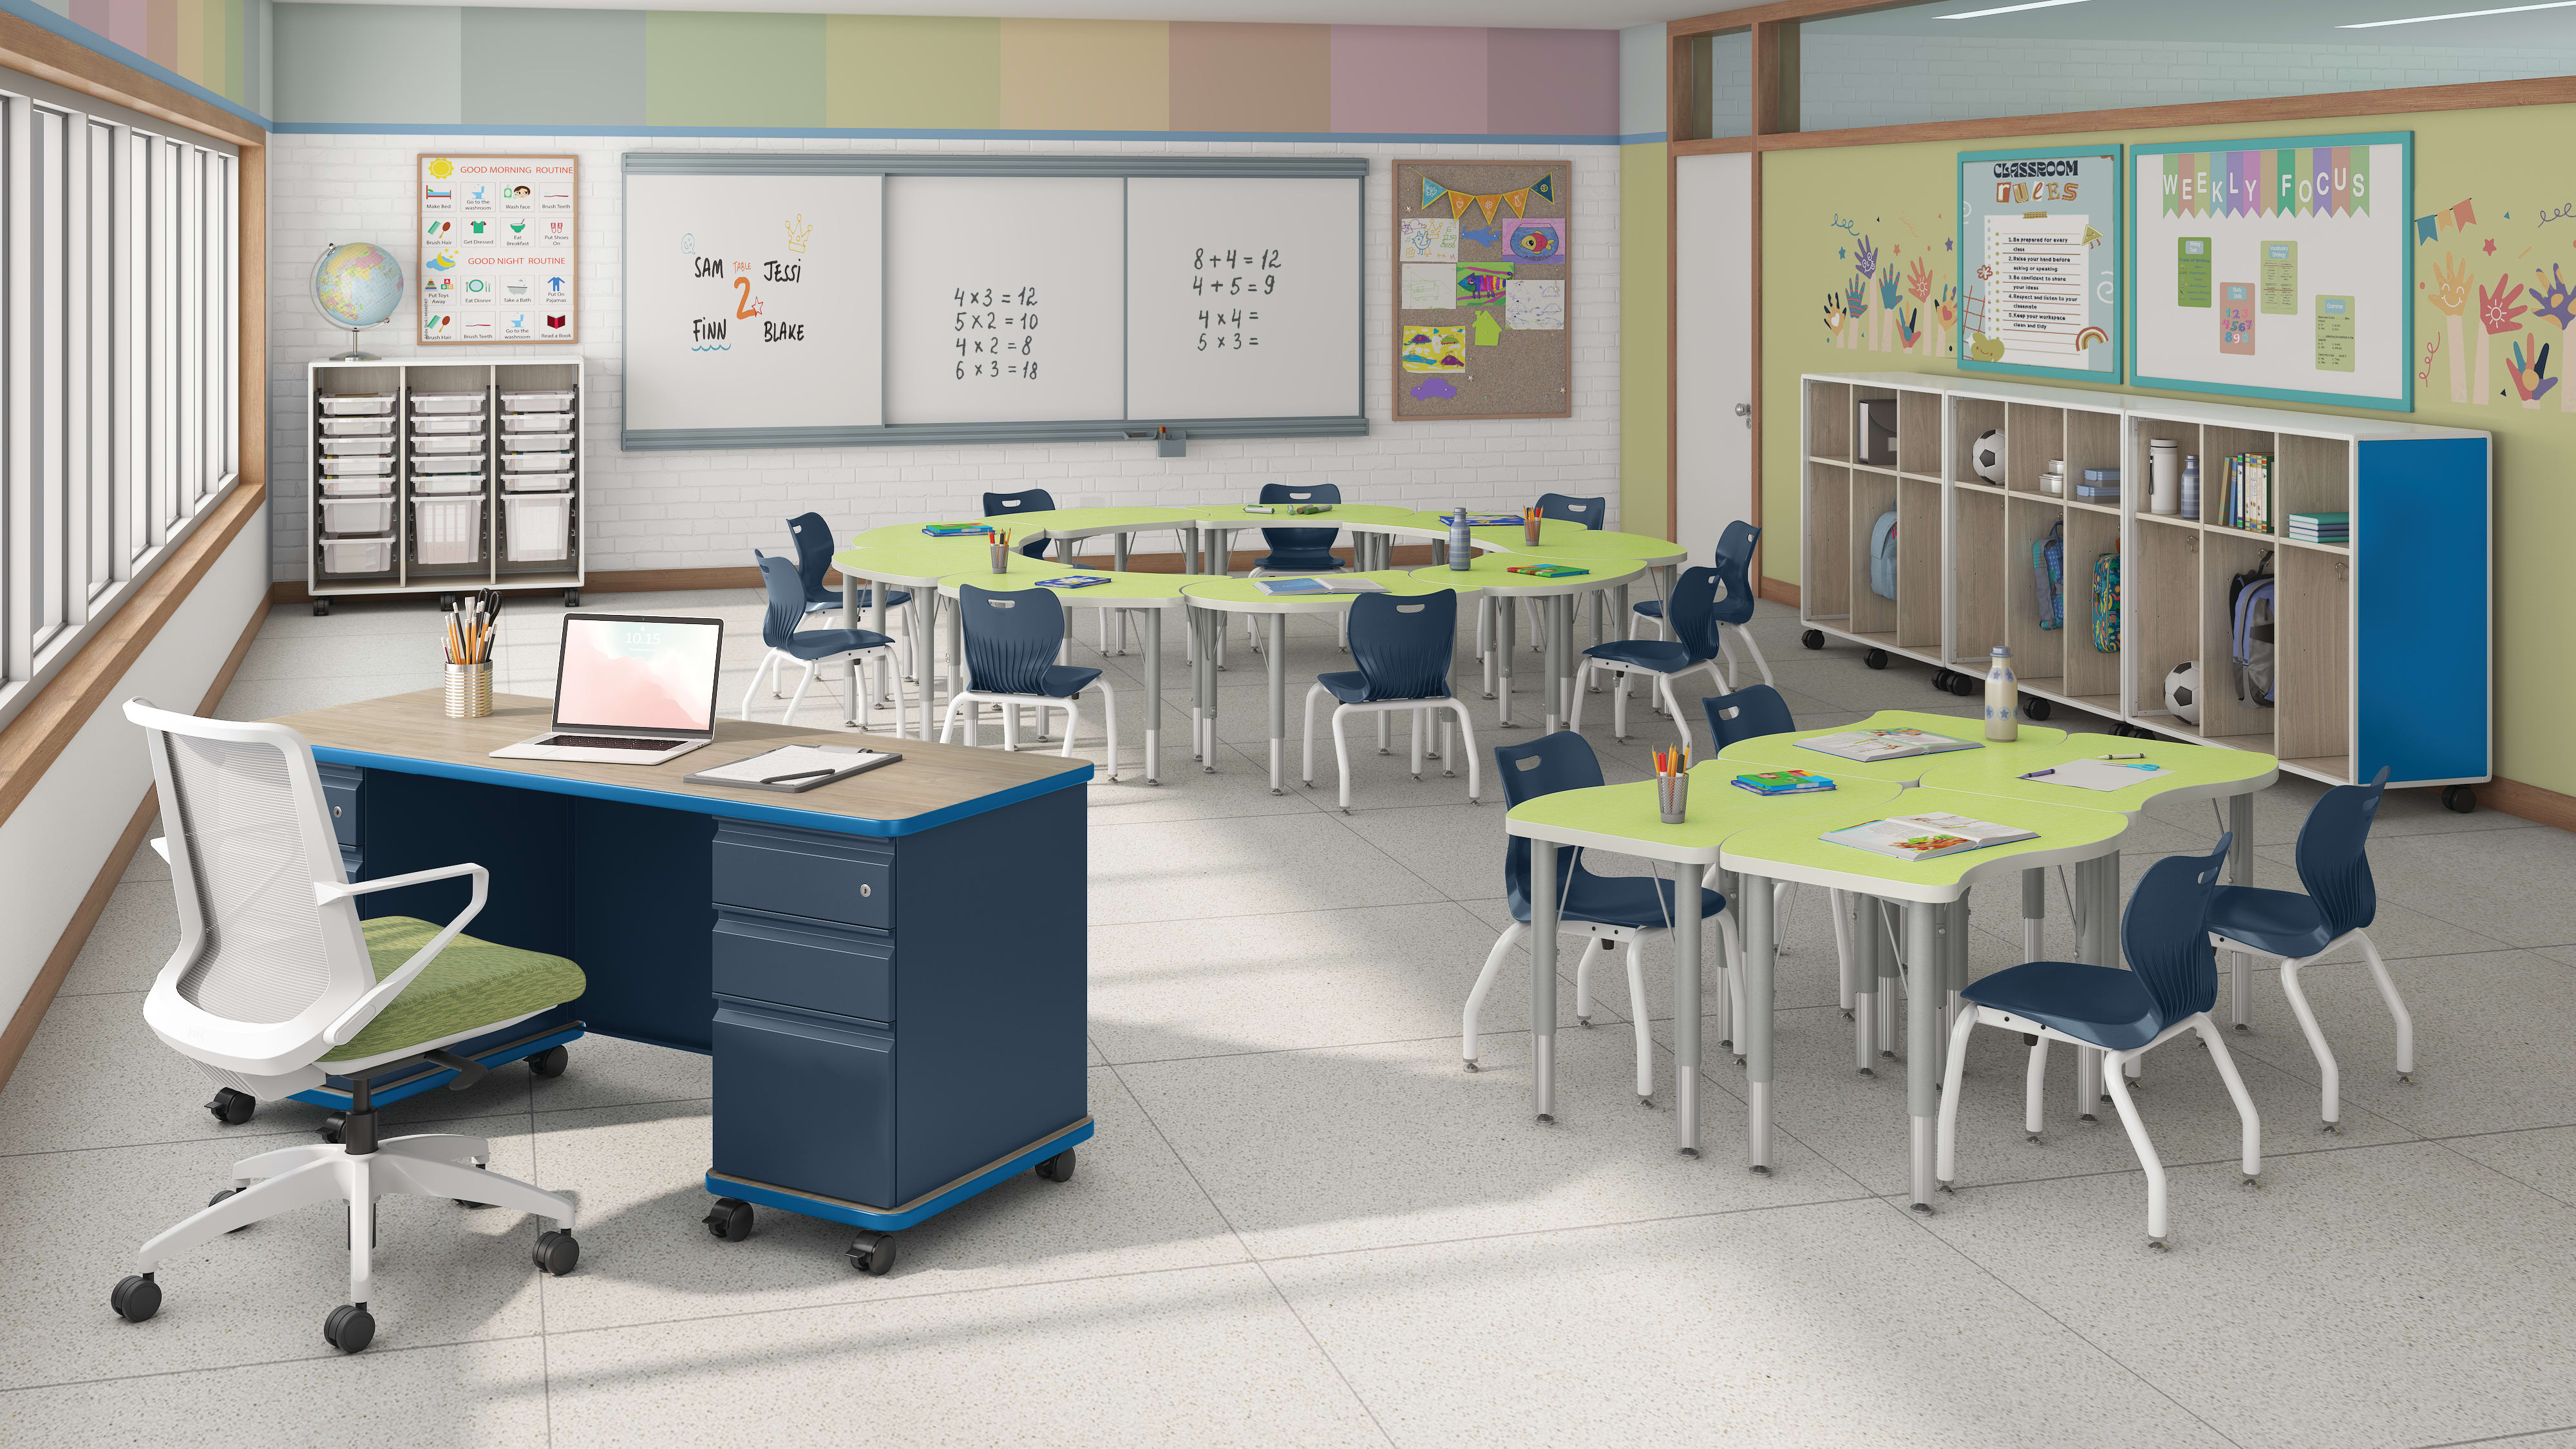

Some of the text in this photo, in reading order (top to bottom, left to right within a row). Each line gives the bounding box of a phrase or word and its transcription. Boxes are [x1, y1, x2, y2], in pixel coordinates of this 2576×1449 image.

[1994, 160, 2078, 178] CLASSROOM
[2163, 167, 2365, 202] WEEKLY FOCUS
[695, 256, 723, 278] SAM
[733, 260, 752, 274] TABLE
[1194, 247, 1204, 270] 8
[1226, 249, 1237, 269] 4
[1262, 249, 1282, 270] 12
[1193, 275, 1203, 296] 4
[1230, 276, 1242, 296] 5
[1264, 274, 1275, 295] 9
[734, 276, 756, 319] 2
[954, 287, 965, 308] 4
[982, 288, 992, 307] 3
[1018, 286, 1038, 307] 12
[954, 312, 967, 332] 5
[987, 312, 996, 330] 2
[1020, 312, 1038, 330] 10
[1198, 310, 1209, 329] 4
[1231, 308, 1242, 329] 4
[764, 321, 804, 342] BLAKE
[1197, 332, 1208, 352] 5
[1233, 332, 1242, 350] 3
[956, 337, 966, 357] 4
[990, 336, 998, 355] 2
[1021, 335, 1032, 355] 8
[956, 360, 965, 380] 6
[990, 360, 999, 377] 3
[1023, 361, 1038, 380] 18
